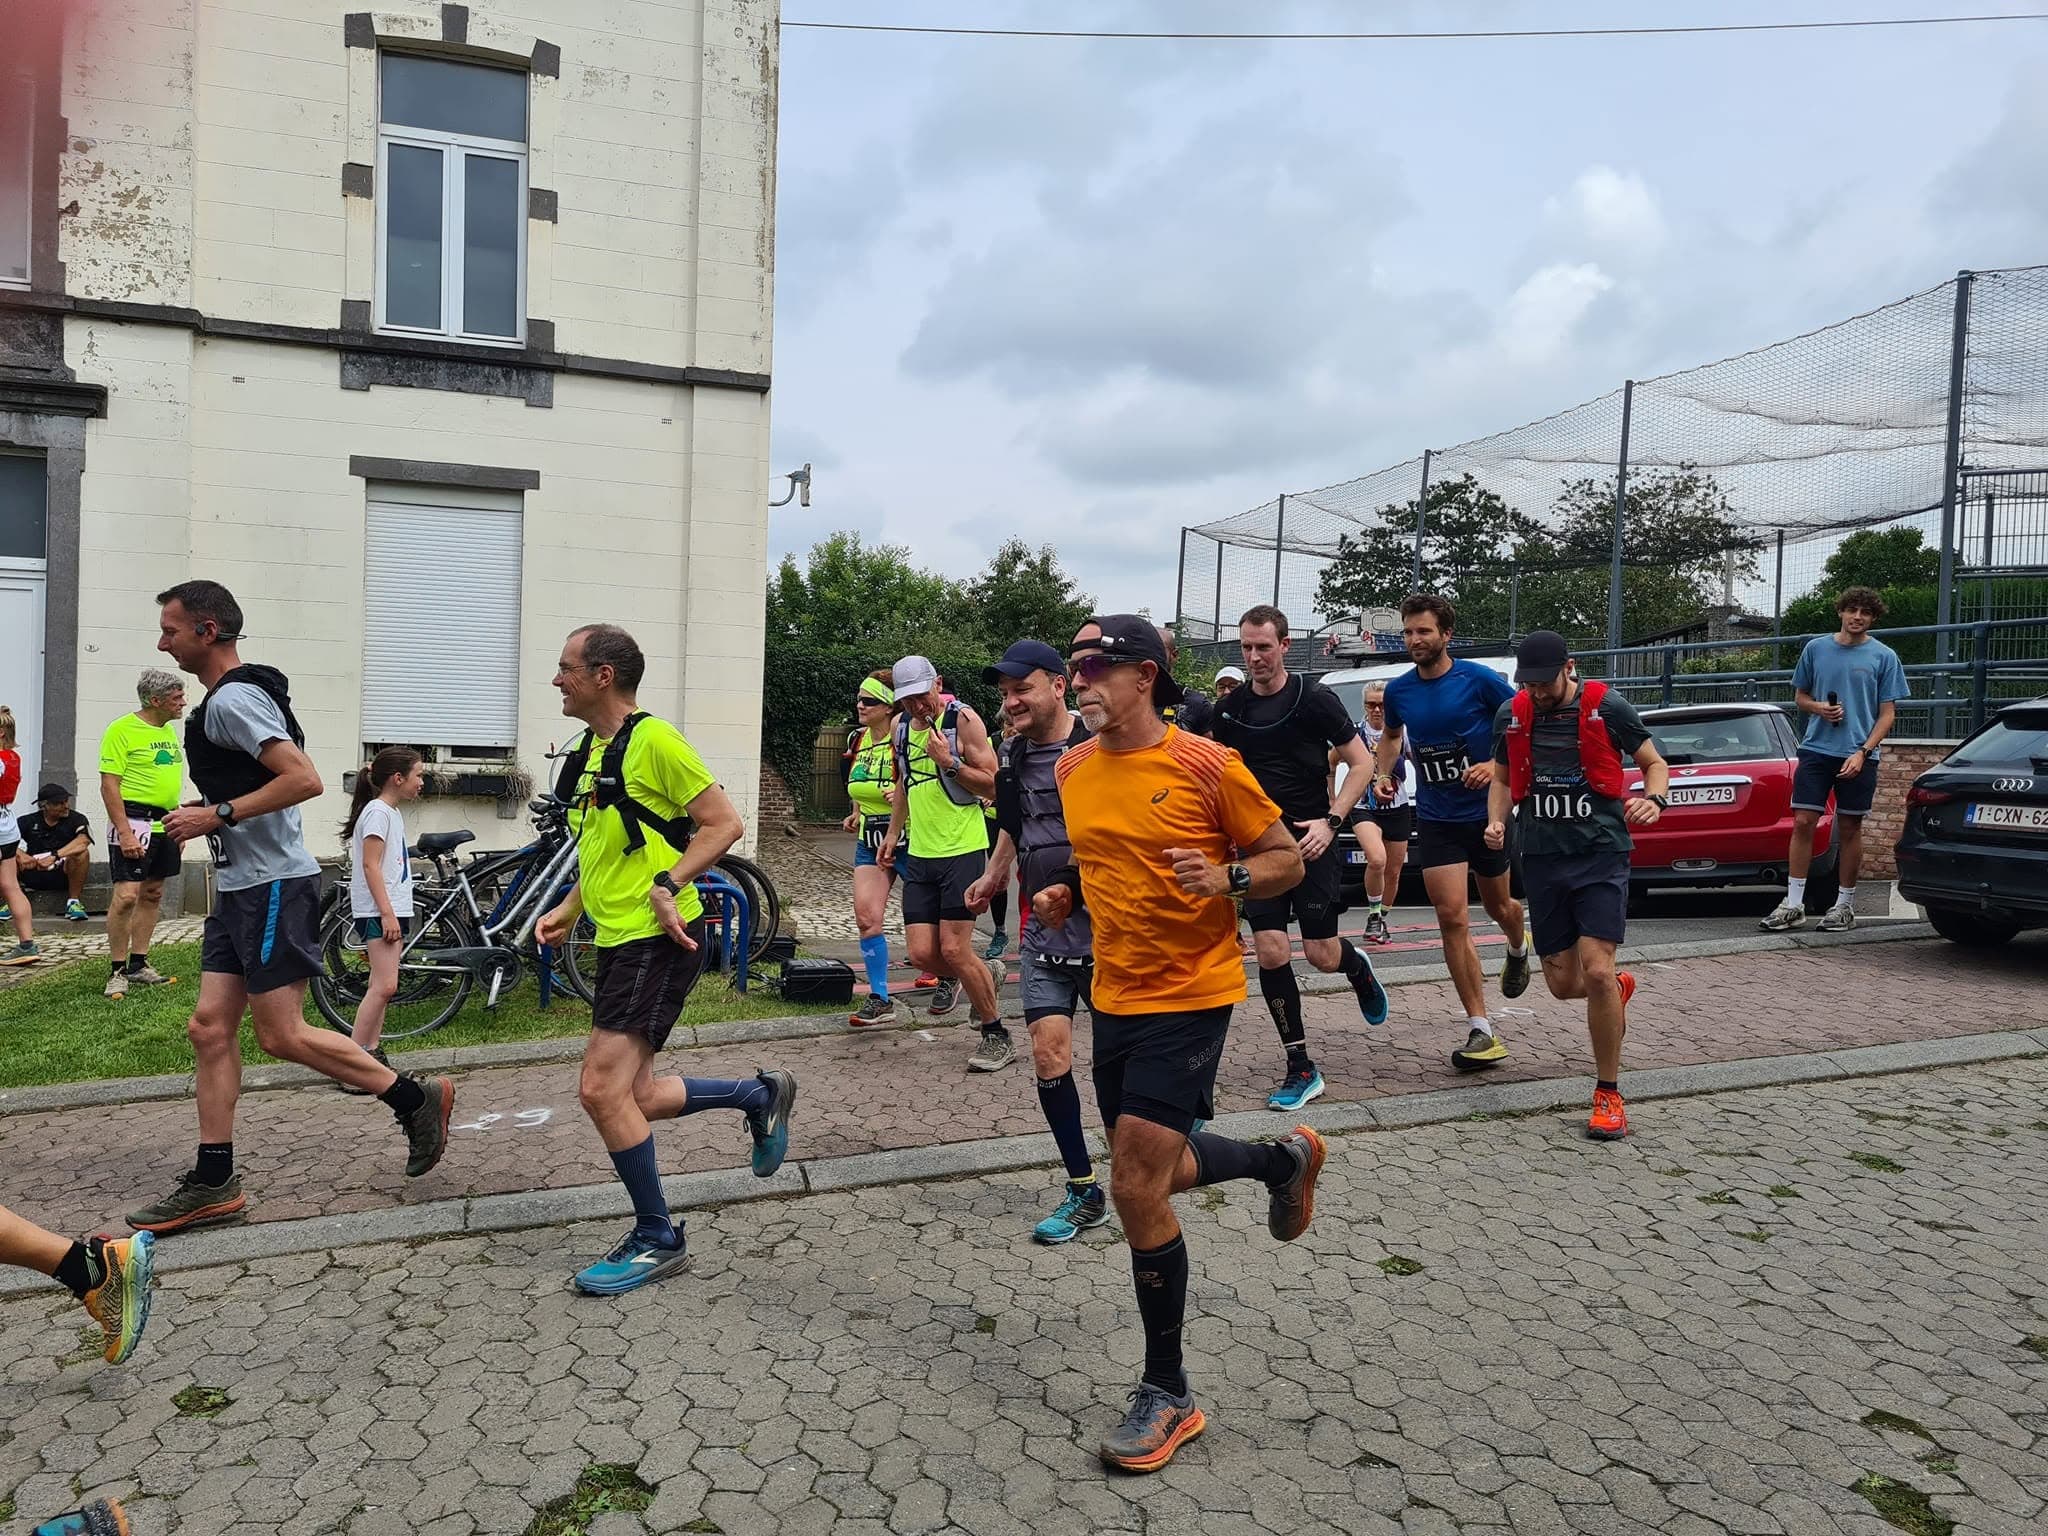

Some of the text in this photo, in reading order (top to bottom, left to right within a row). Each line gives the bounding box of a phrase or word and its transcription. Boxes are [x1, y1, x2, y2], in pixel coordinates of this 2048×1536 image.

[1421, 755, 1471, 783] 1154
[1554, 775, 1580, 783] TIMING
[1533, 793, 1593, 819] 1016
[865, 829, 907, 849] 102
